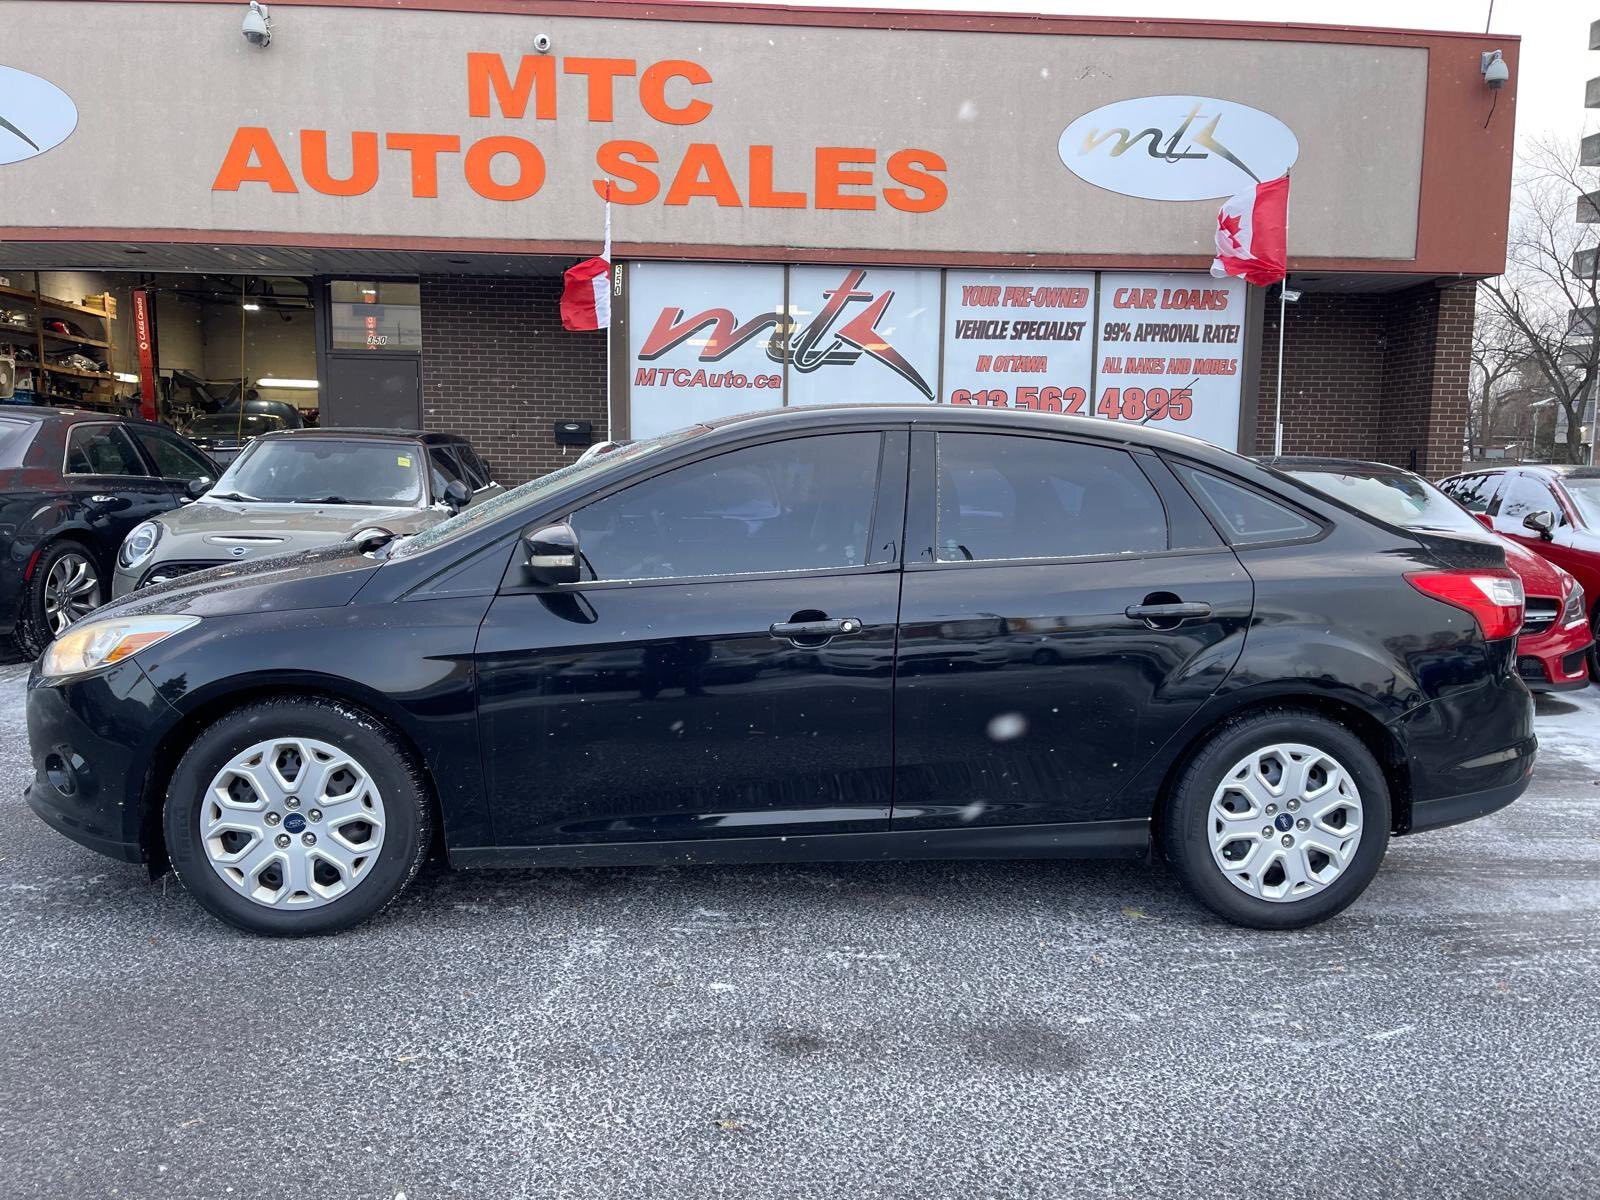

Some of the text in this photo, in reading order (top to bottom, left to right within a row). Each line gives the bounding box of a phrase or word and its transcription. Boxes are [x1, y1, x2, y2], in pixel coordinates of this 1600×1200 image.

[467, 52, 714, 126] MTC
[211, 126, 948, 213] AUTO SALES
[615, 264, 623, 296] 350
[962, 285, 1090, 309] YOUR PRE-OWNED
[1113, 288, 1230, 311] CAR LOANS
[367, 335, 388, 345] 350
[955, 319, 1087, 341] VEHICLE SPECIALIST
[1103, 322, 1241, 344] 99% APPROVAL RATE!
[975, 355, 1048, 373] IN OTTAWA
[1102, 357, 1238, 376] ALL MAKES AND MODELS
[634, 367, 782, 389] MTCAuto.ca
[1015, 386, 1087, 415] 562
[1098, 387, 1194, 421] 4895
